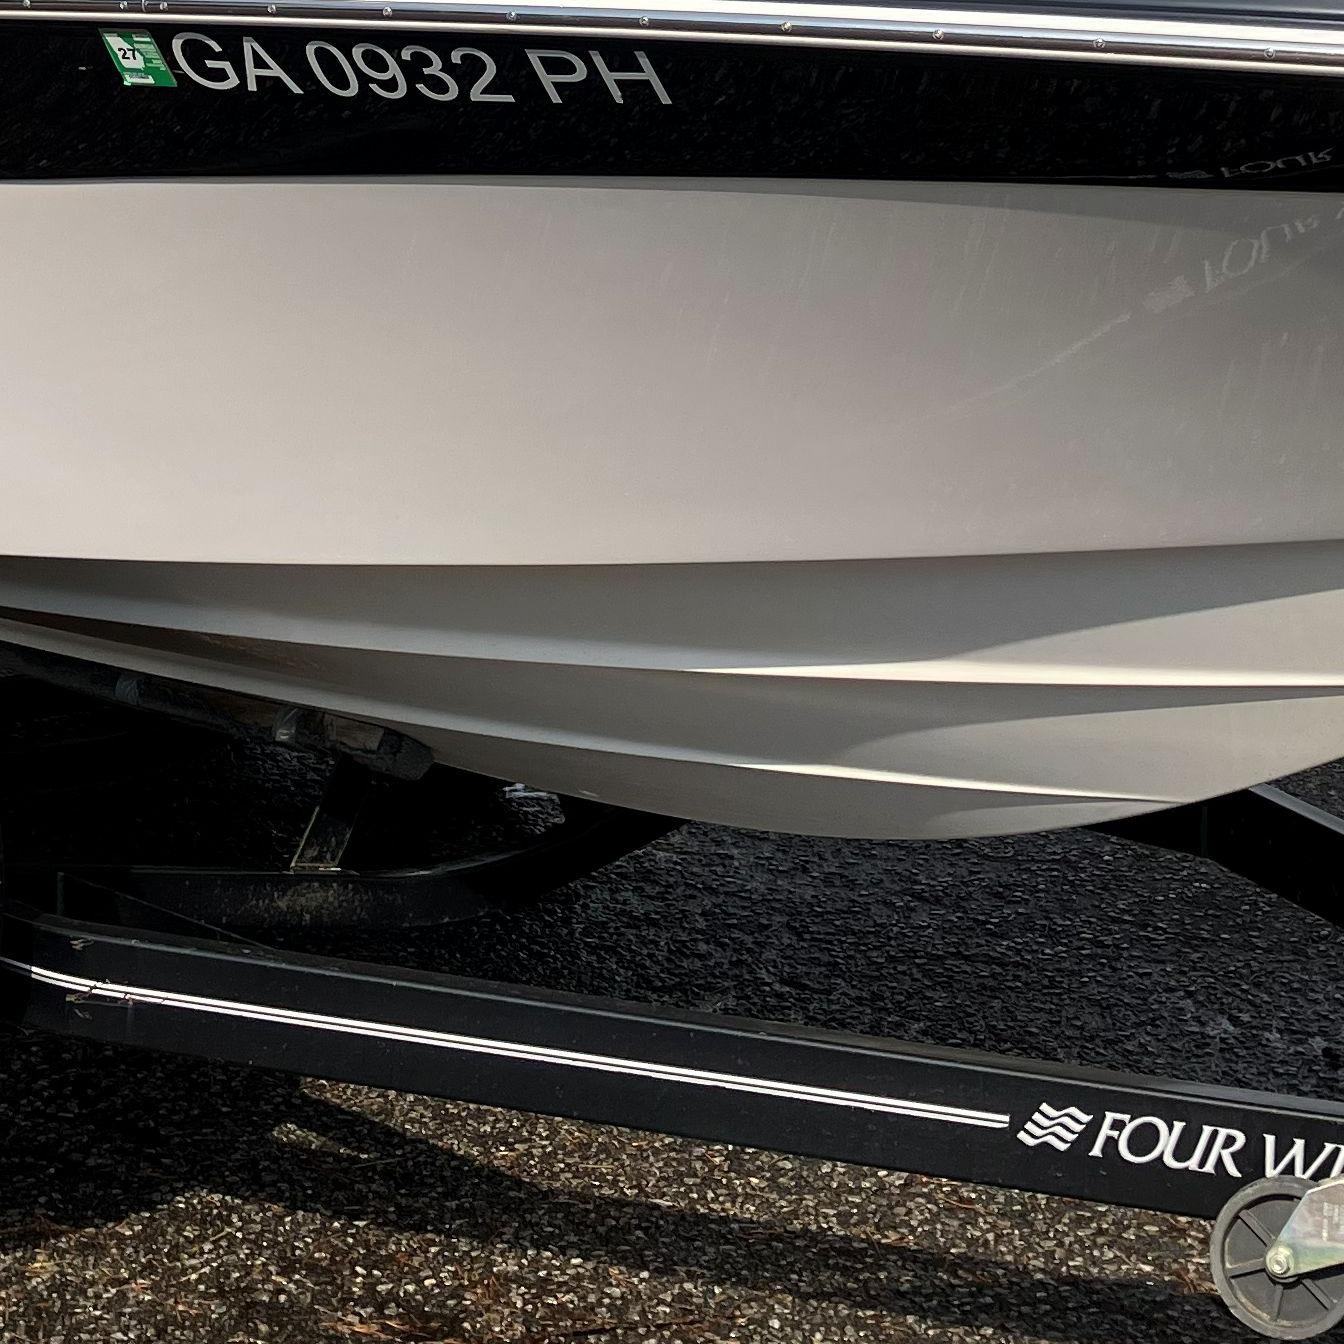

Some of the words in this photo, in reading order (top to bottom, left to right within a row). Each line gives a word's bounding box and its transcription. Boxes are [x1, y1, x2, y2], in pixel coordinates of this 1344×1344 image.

[118, 47, 137, 61] 27
[171, 32, 304, 95] GA
[305, 42, 516, 103] 0932
[524, 47, 674, 105] PH
[1088, 1111, 1246, 1178] FOUR
